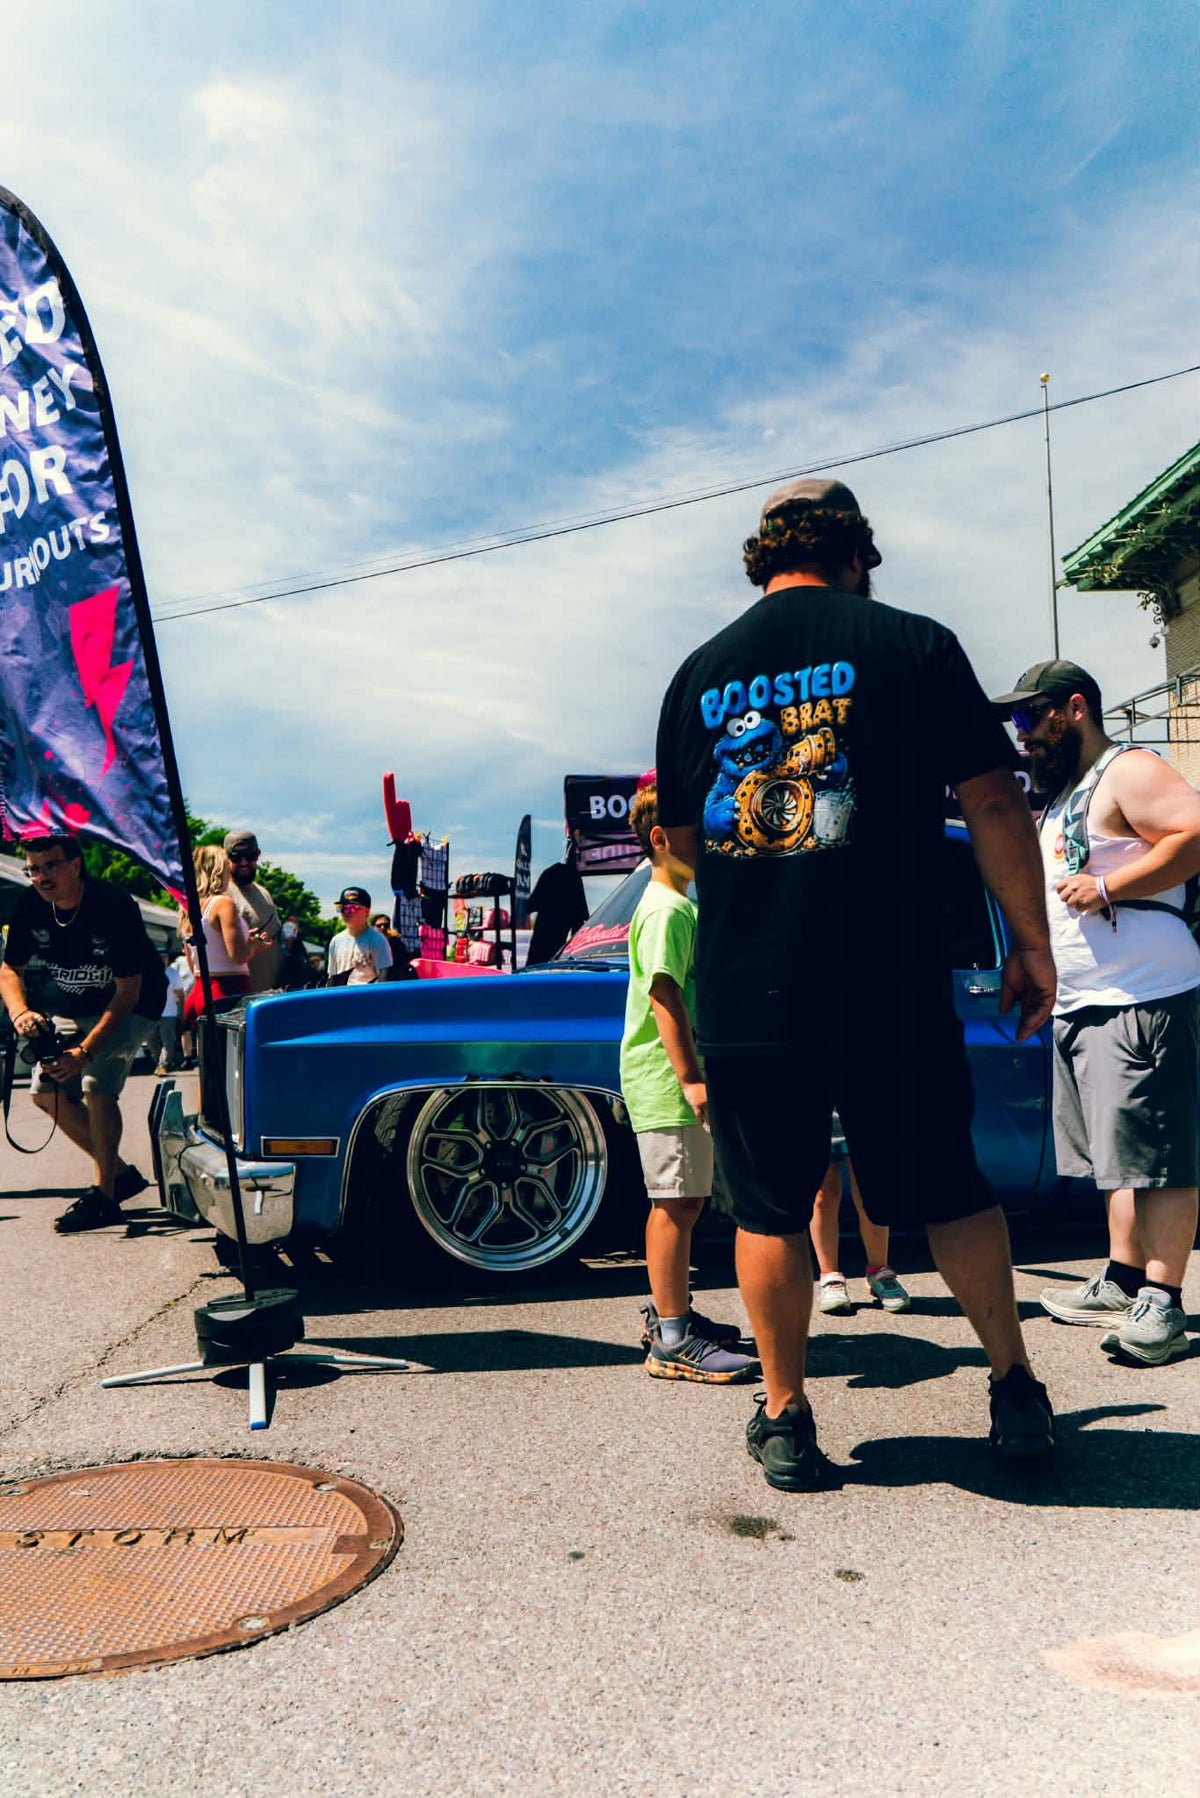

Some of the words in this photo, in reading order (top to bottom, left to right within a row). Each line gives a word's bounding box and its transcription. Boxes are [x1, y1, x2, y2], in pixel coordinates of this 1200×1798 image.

[0, 363, 79, 438] NEY
[701, 660, 856, 729] BOOSTED
[780, 698, 852, 735] BRAT
